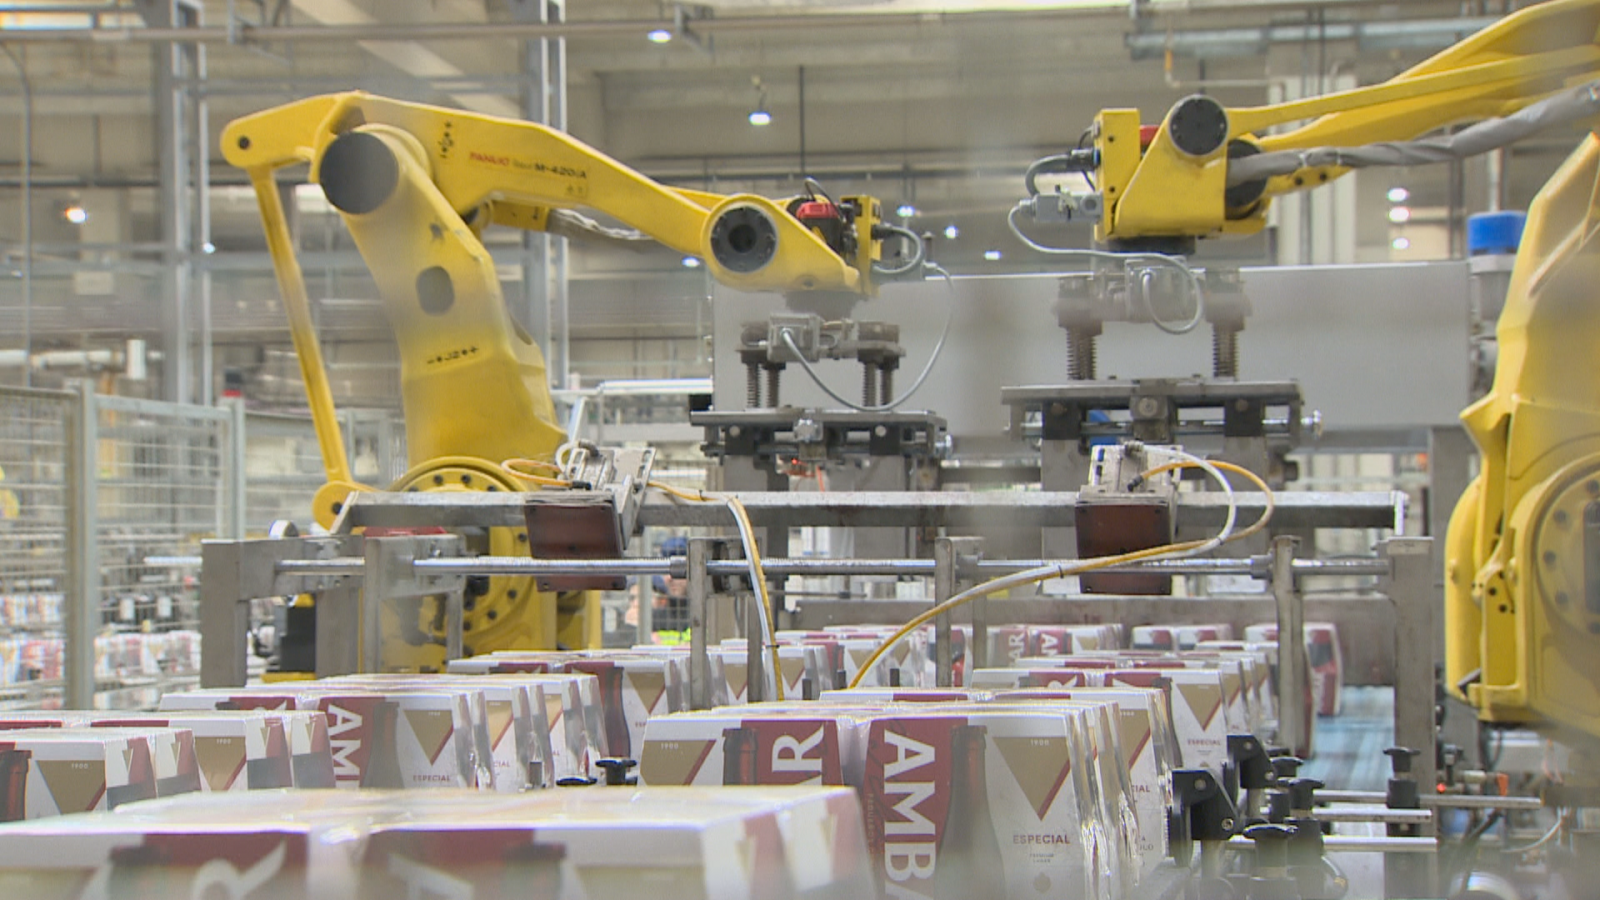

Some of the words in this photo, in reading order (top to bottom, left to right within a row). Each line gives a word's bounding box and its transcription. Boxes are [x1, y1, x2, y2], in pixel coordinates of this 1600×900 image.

[469, 151, 510, 167] FANUC
[660, 742, 679, 750] 1900
[1030, 739, 1050, 747] 1900
[70, 762, 89, 770] 1900
[412, 774, 450, 782] ESPECIAL
[1012, 834, 1071, 845] ESPECIAL
